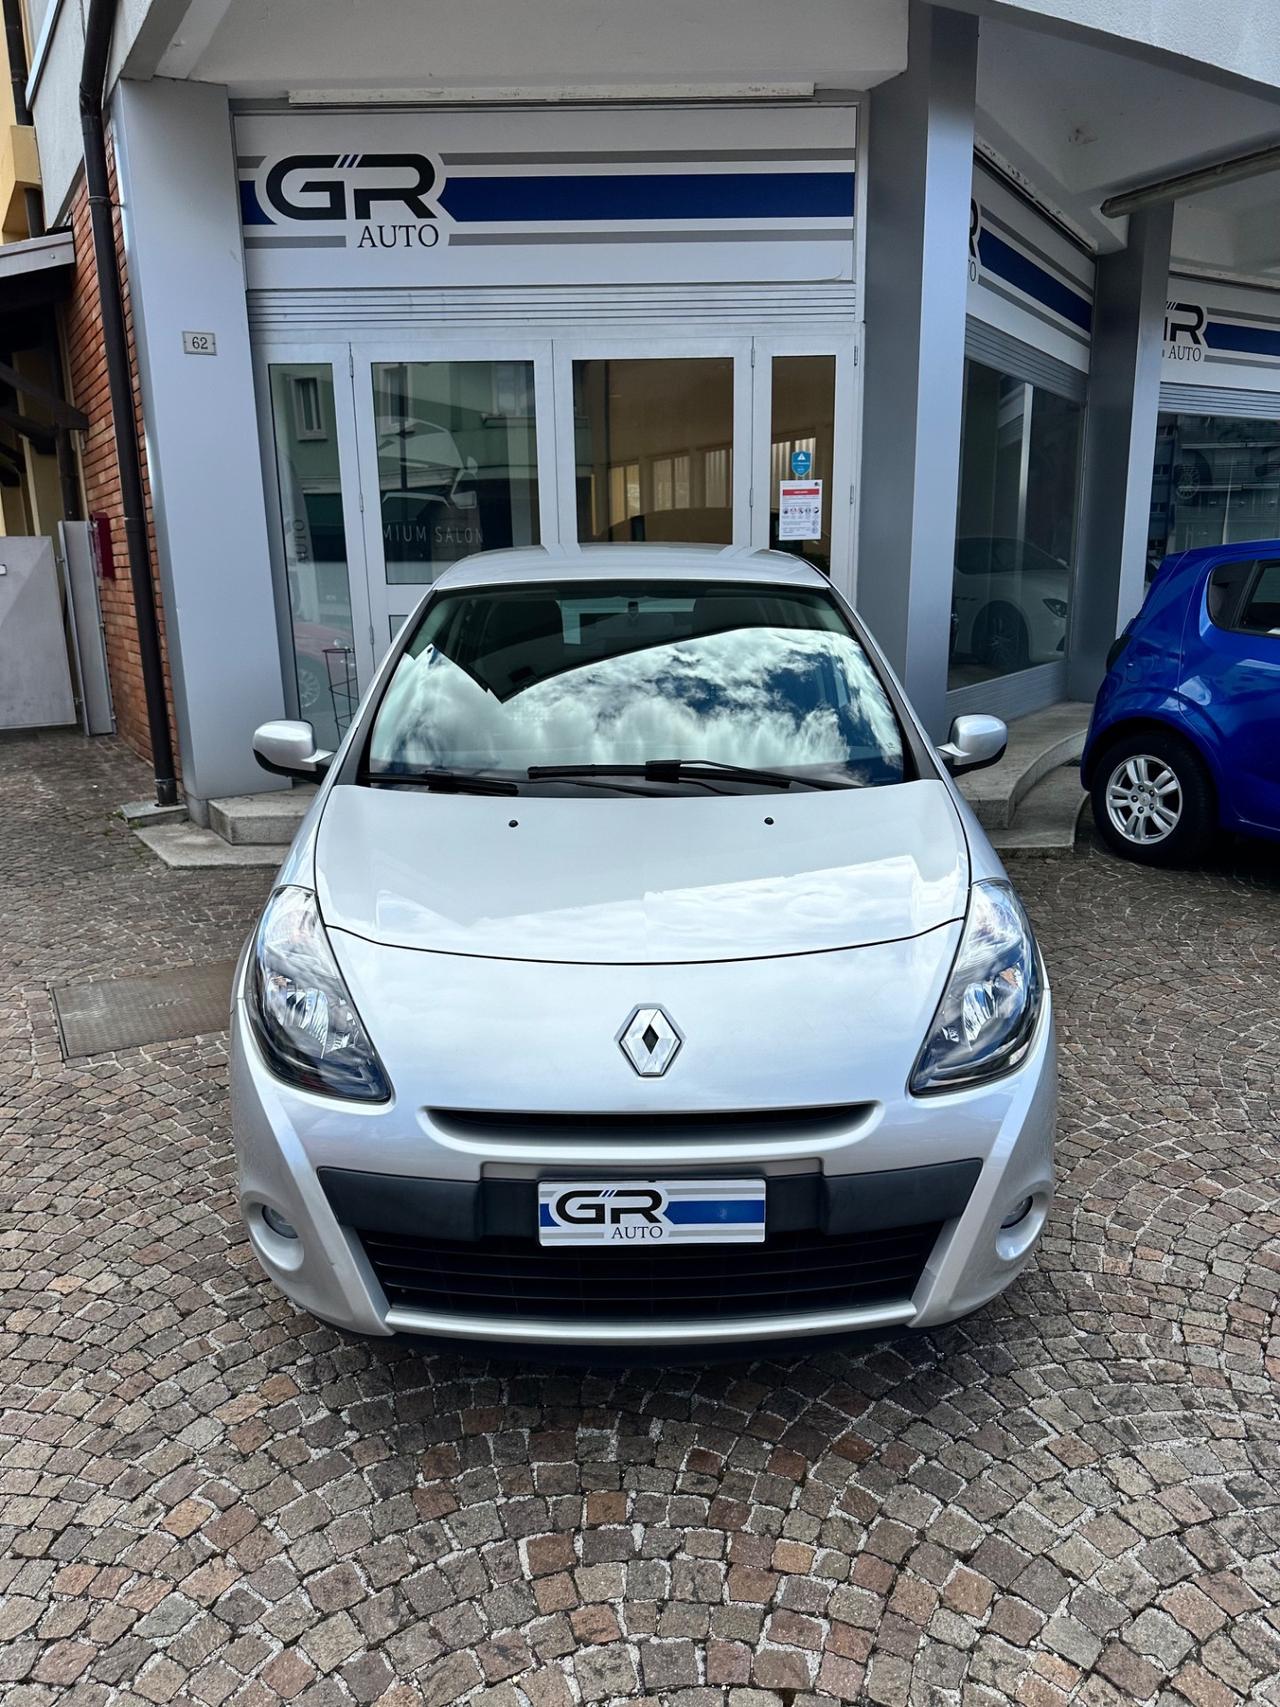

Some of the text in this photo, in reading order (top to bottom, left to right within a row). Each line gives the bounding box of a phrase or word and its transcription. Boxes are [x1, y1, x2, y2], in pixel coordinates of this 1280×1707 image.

[265, 153, 438, 221] GR
[357, 223, 439, 248] AUTO
[192, 336, 208, 350] 62
[1168, 344, 1201, 362] AUTO
[435, 526, 483, 544] SALON
[556, 1189, 663, 1225] GR
[611, 1226, 663, 1239] AUTO
